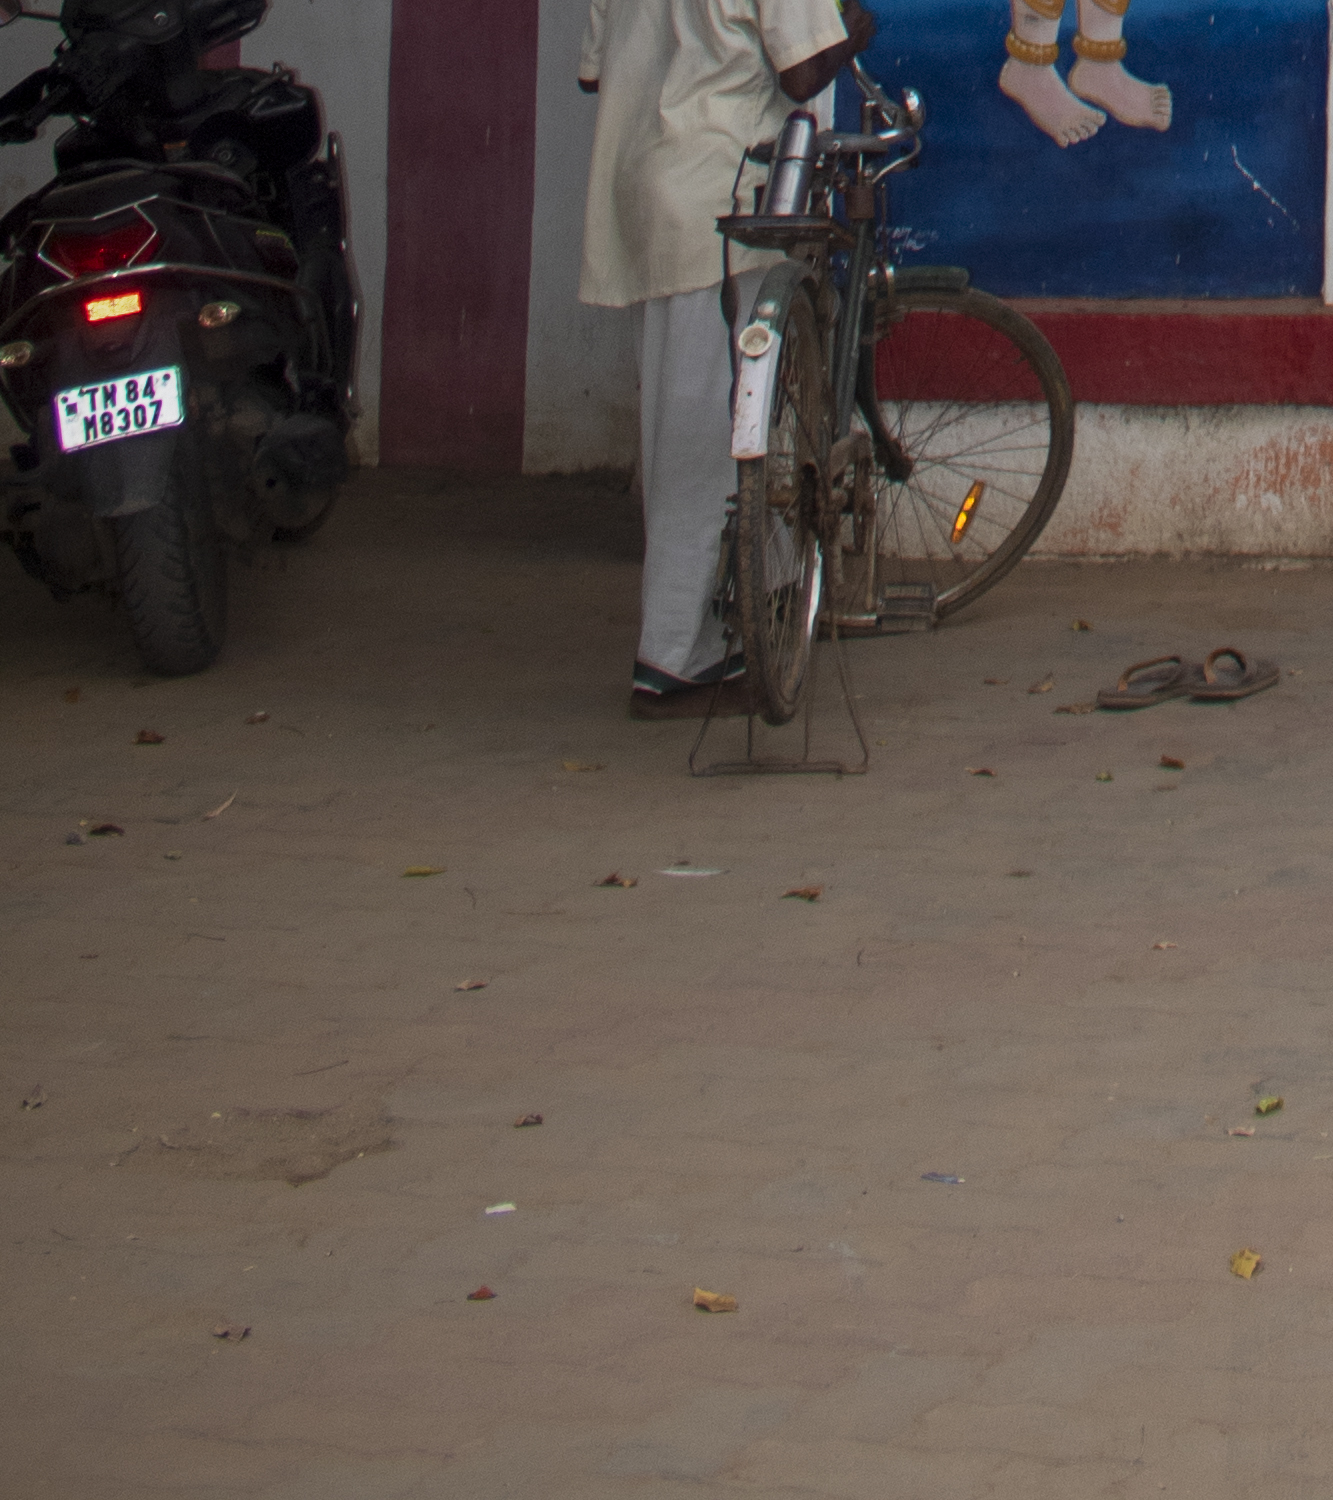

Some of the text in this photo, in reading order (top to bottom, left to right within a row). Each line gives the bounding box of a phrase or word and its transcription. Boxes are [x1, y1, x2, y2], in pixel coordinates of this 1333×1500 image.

[83, 375, 156, 412] TN 84
[83, 399, 163, 442] M8307
